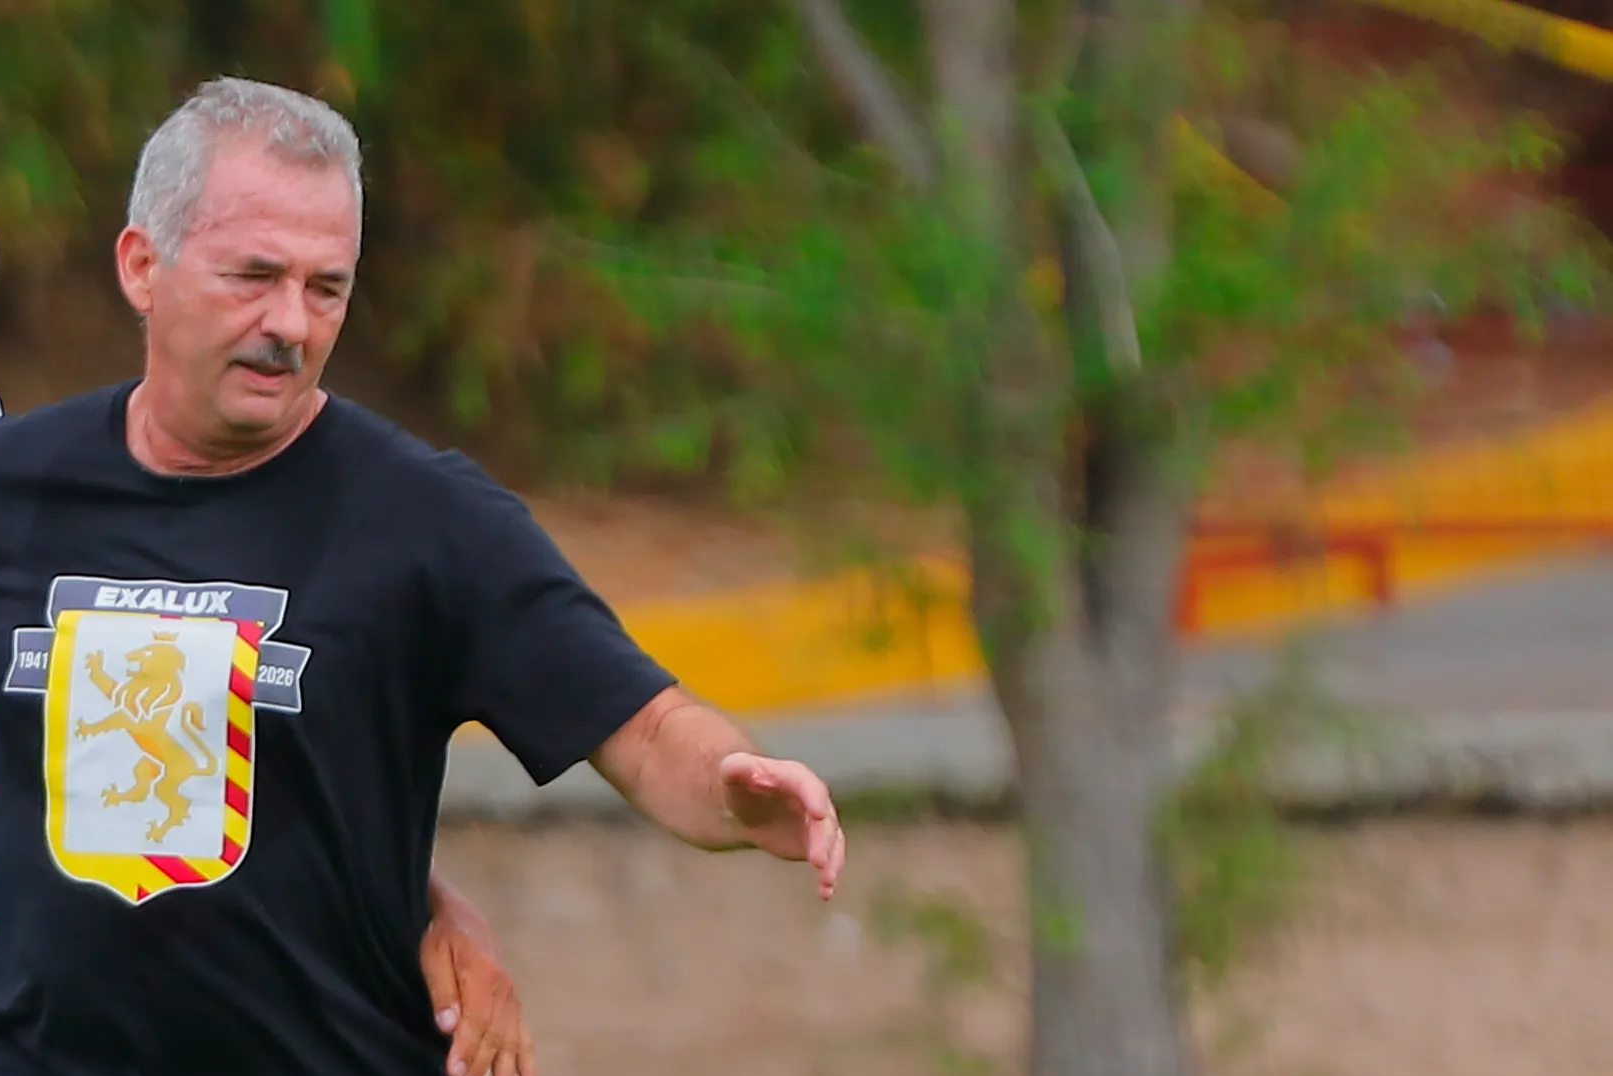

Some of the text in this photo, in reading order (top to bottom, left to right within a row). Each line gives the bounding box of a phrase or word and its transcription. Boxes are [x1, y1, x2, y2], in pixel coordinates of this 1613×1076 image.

[94, 585, 233, 615] EXALUX
[19, 650, 49, 670] 1941
[257, 664, 295, 687] 2026
